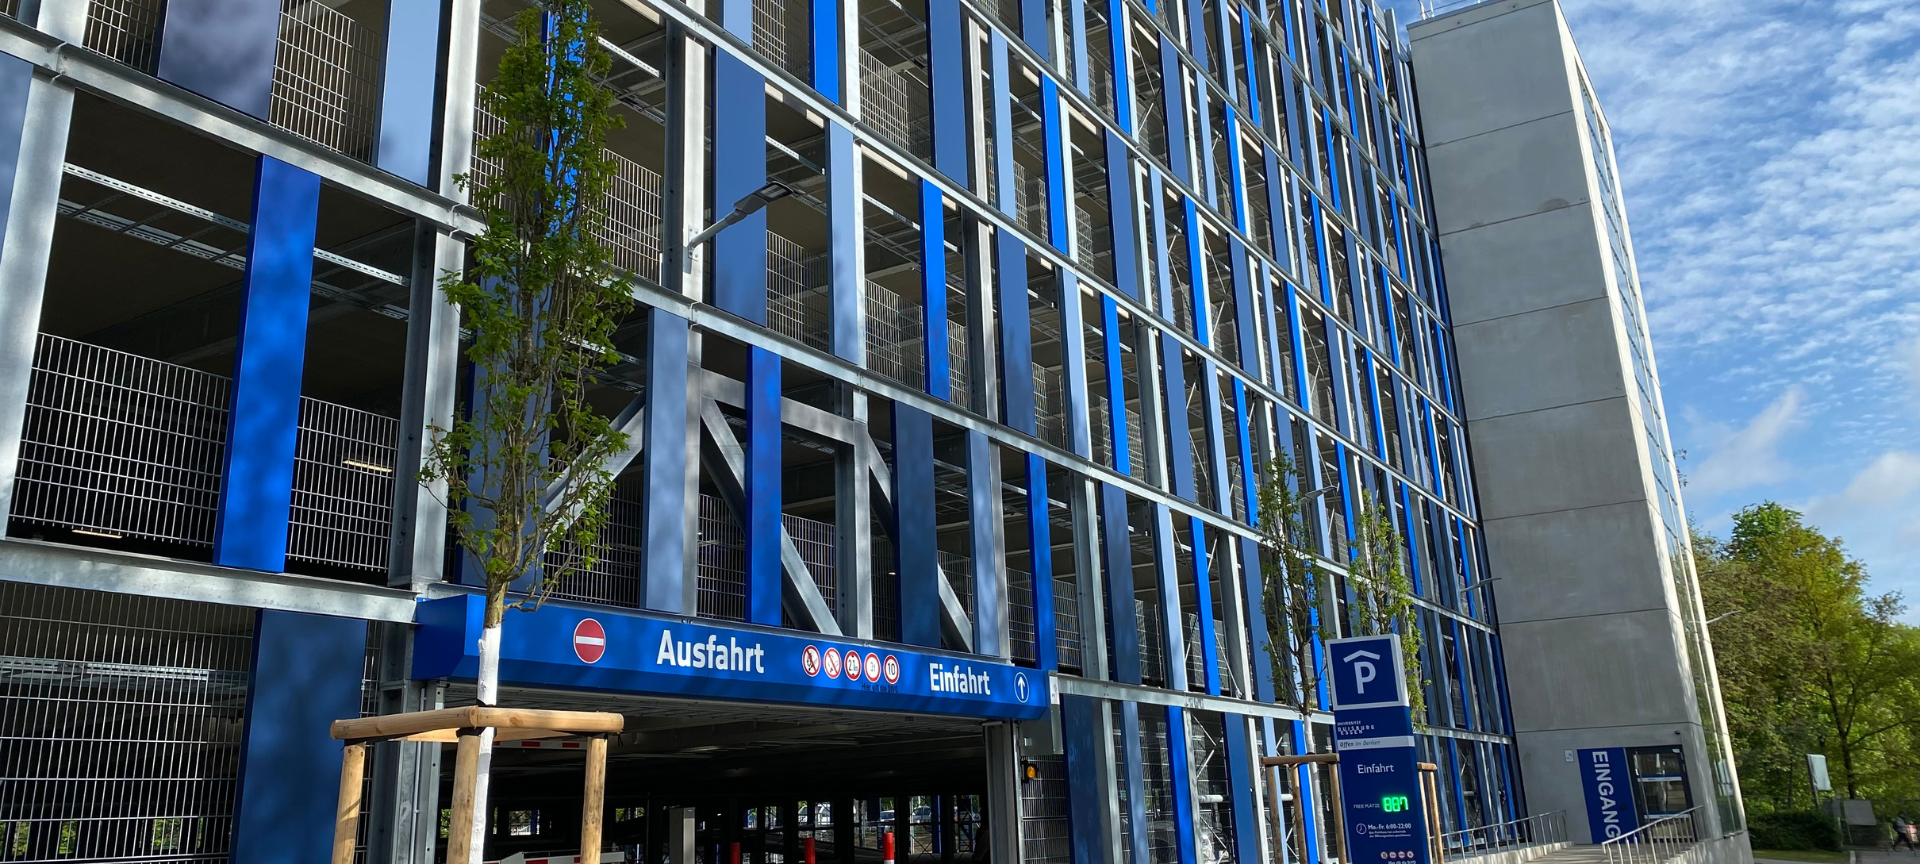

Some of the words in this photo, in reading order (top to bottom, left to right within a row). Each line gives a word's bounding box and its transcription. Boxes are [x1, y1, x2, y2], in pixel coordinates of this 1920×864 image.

[657, 629, 765, 674] Ausfahrt
[887, 662, 896, 676] 10
[929, 662, 991, 696] Einfahrt
[1353, 661, 1377, 694] P
[1337, 724, 1375, 732] DUISBURG
[1340, 741, 1354, 749] Offen
[1357, 763, 1395, 774] Einfahrt
[1592, 750, 1622, 840] EINGANG
